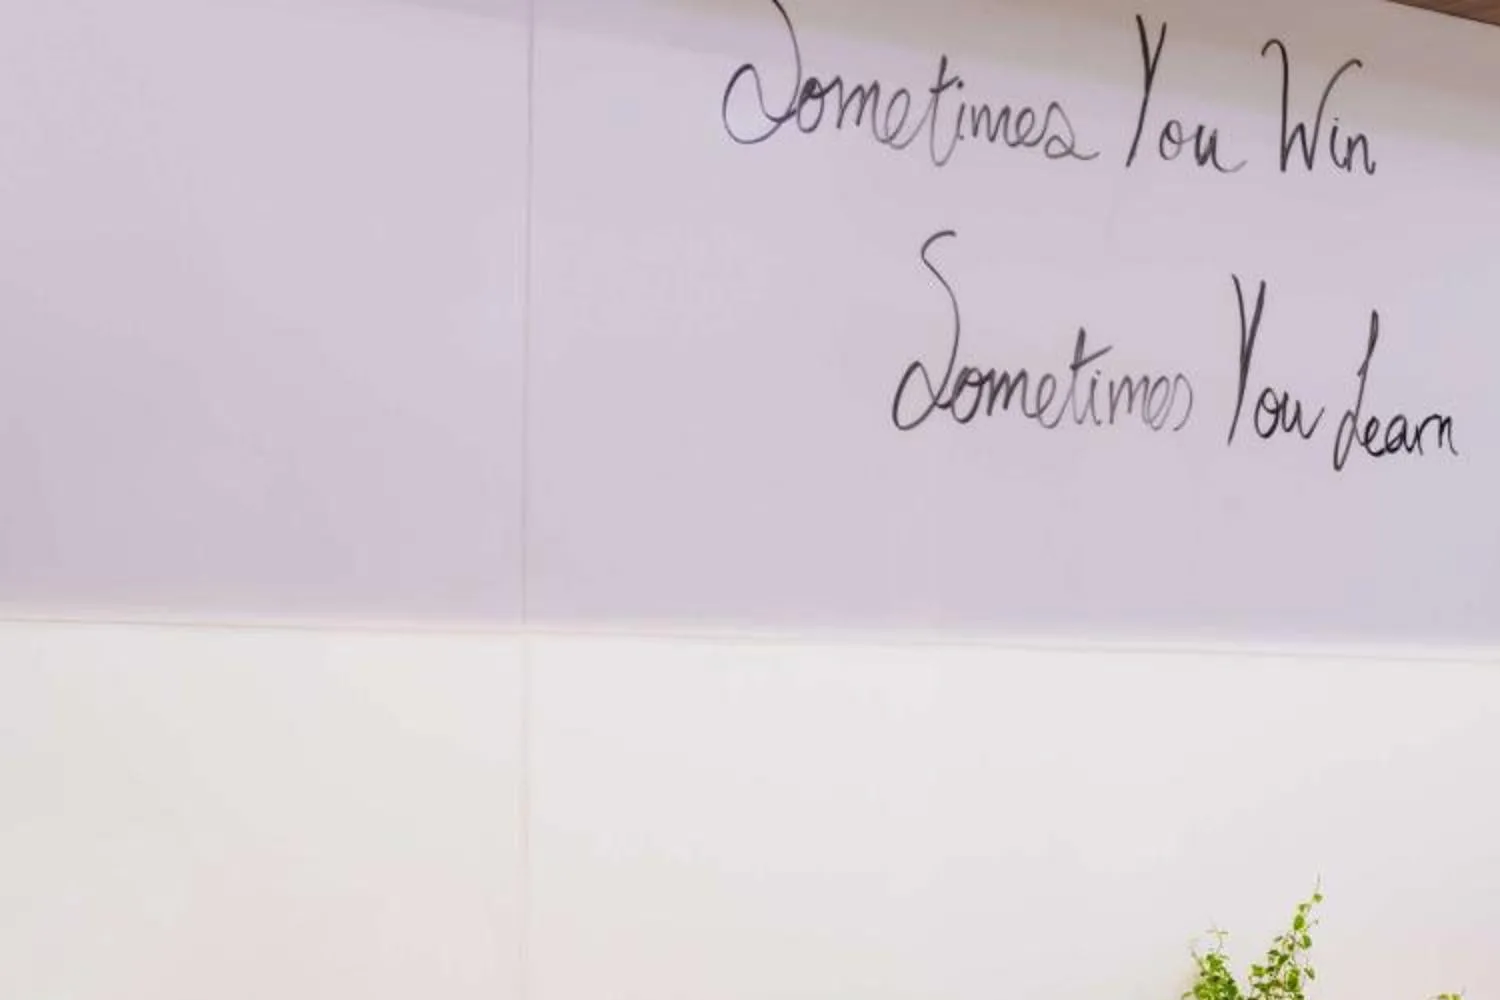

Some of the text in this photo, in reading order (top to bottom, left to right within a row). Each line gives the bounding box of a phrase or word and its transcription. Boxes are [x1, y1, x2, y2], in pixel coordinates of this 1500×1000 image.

[722, 0, 1376, 176] Sometimes You Win
[891, 229, 1460, 472] Sometimes You Learn
